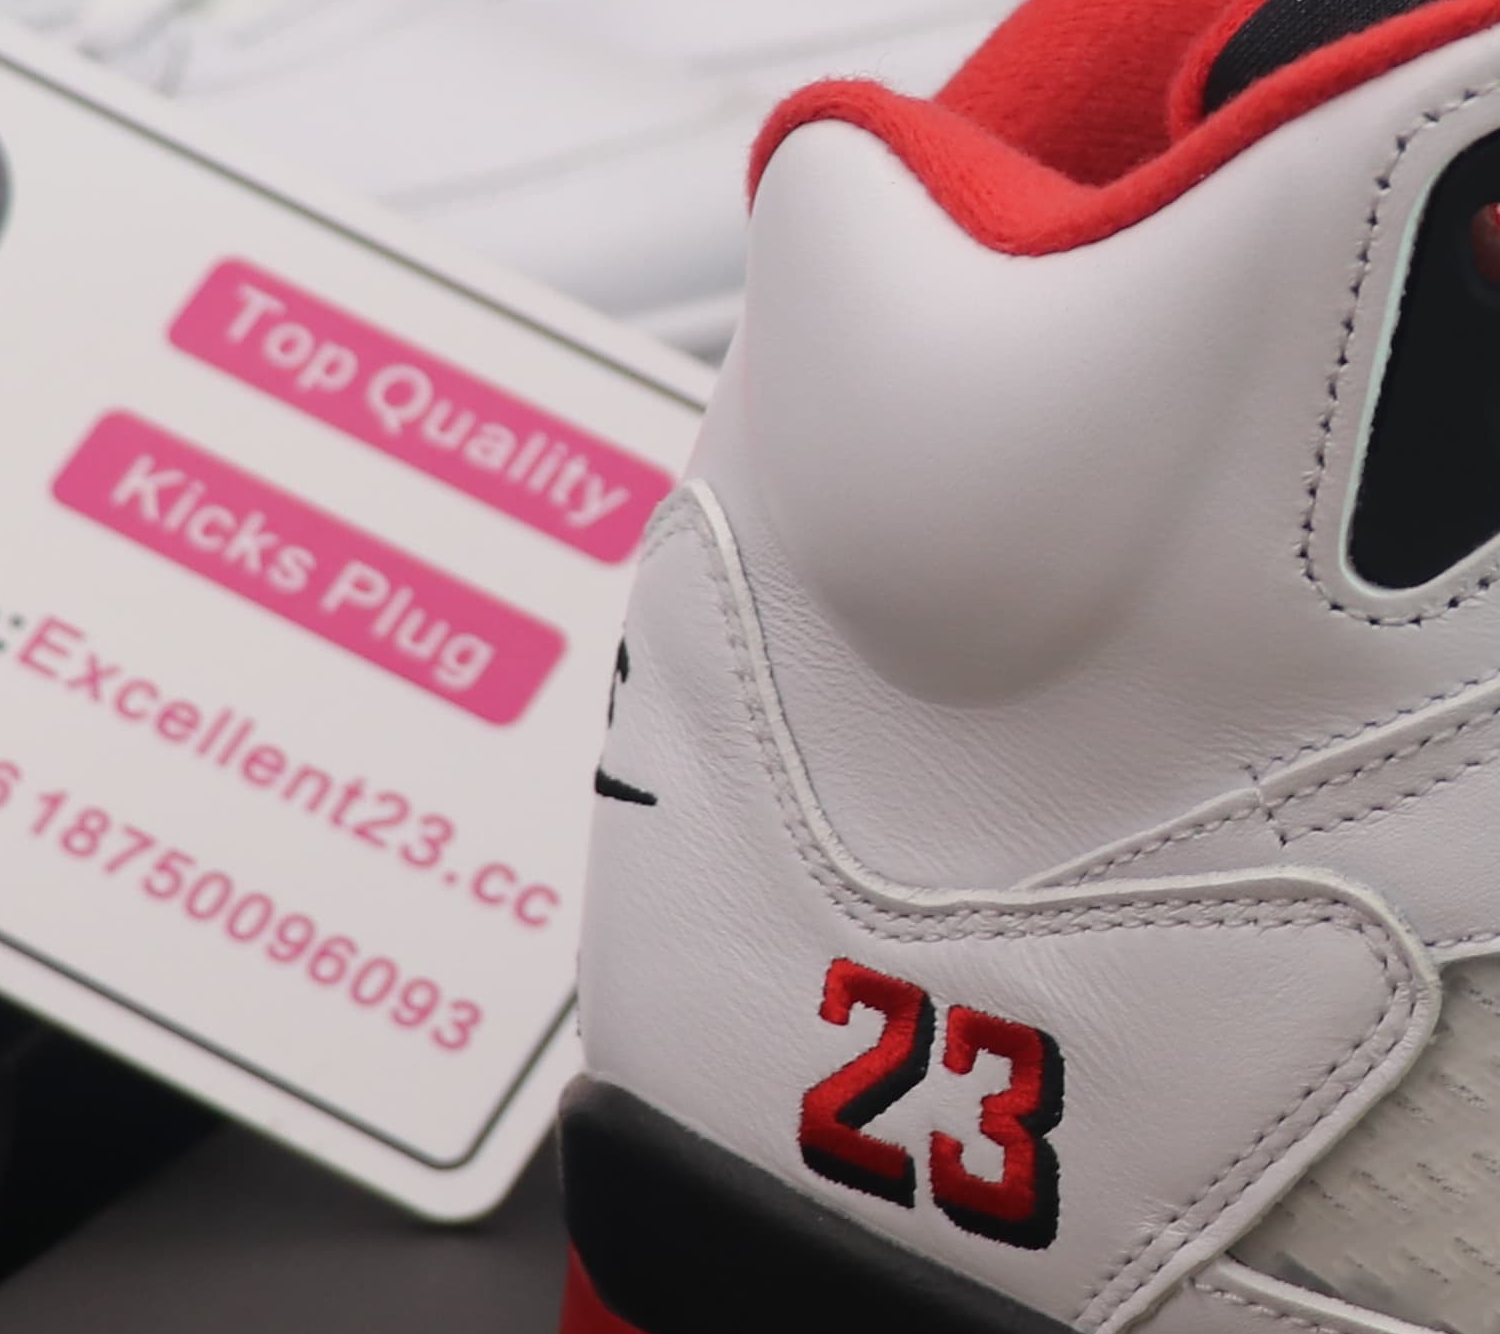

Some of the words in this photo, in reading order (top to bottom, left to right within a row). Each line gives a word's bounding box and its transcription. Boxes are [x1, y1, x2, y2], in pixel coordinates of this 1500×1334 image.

[222, 283, 360, 393] Top
[364, 363, 632, 530] Quality
[110, 453, 318, 595] Kicks
[319, 558, 496, 692] Plug
[797, 957, 1066, 1251] 23
